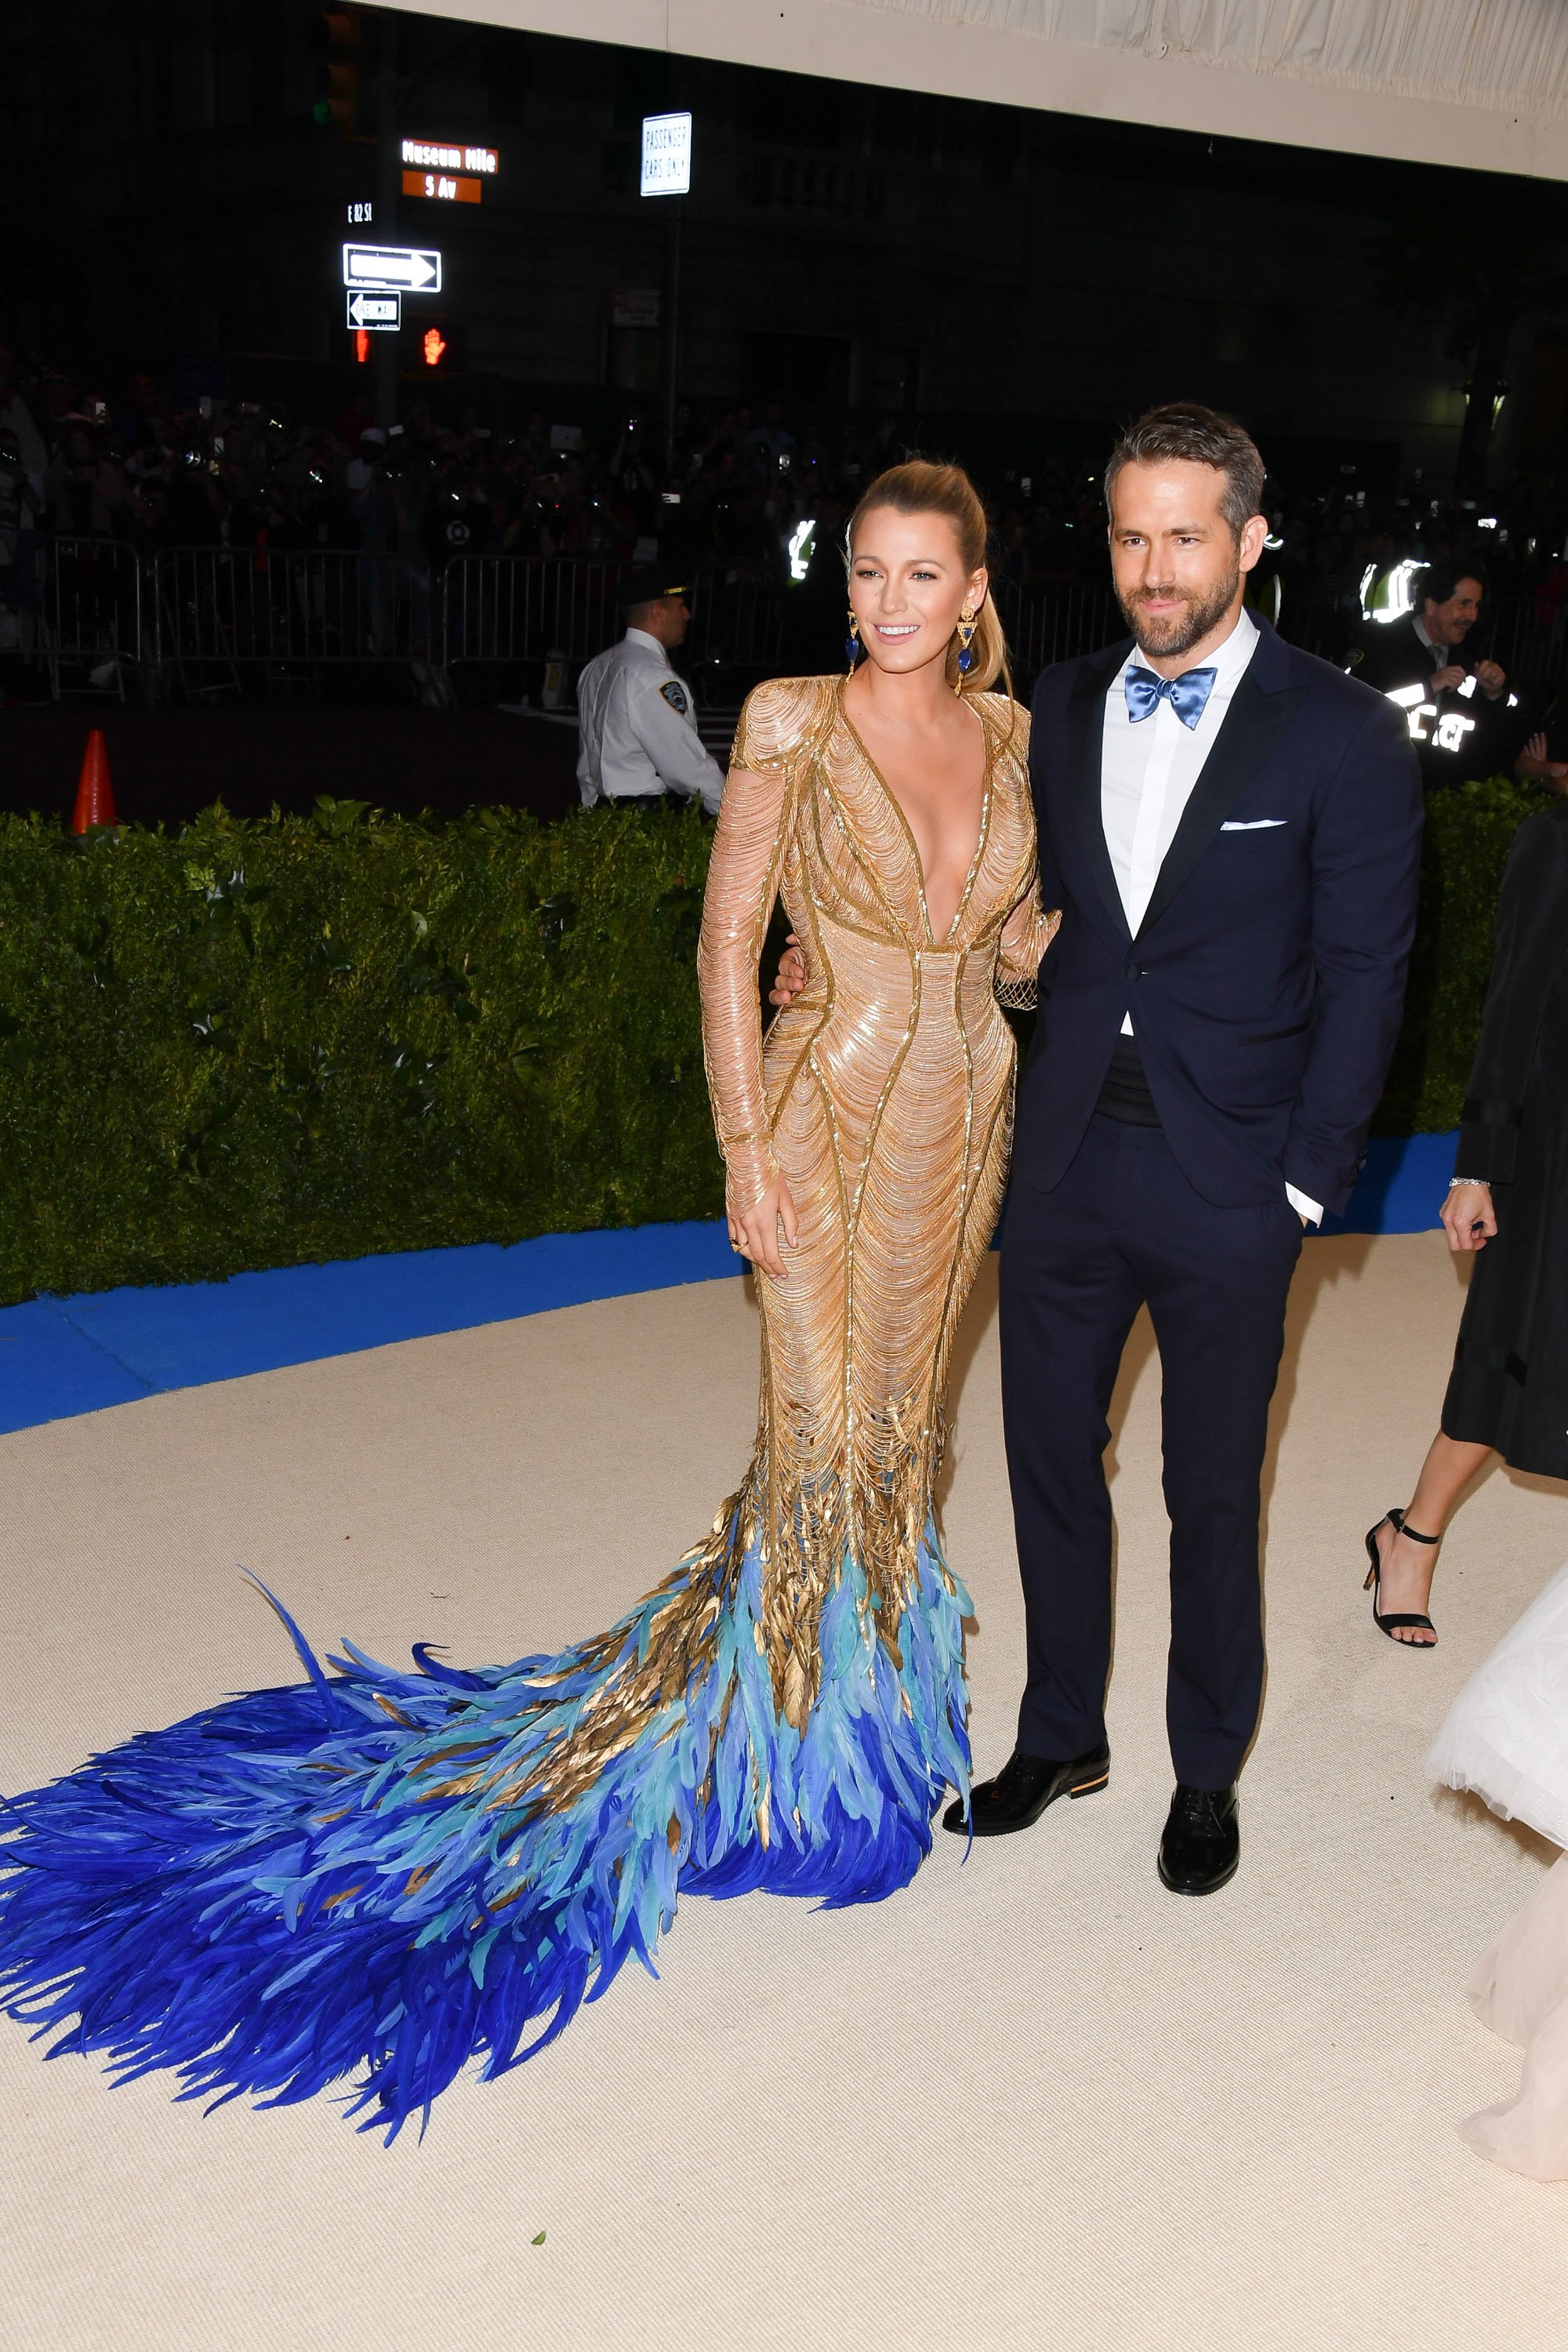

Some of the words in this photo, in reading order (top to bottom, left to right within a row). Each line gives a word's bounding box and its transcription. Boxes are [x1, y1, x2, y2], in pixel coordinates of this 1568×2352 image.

[646, 126, 687, 151] PASSENGER
[402, 140, 461, 168] Museum
[465, 148, 495, 172] Mile
[645, 158, 662, 180] CARS
[667, 156, 686, 177] ONLY
[425, 175, 434, 197] 5
[437, 176, 456, 199] Av
[354, 203, 363, 222] 82
[355, 303, 370, 317] ONE
[377, 303, 393, 317] WAY
